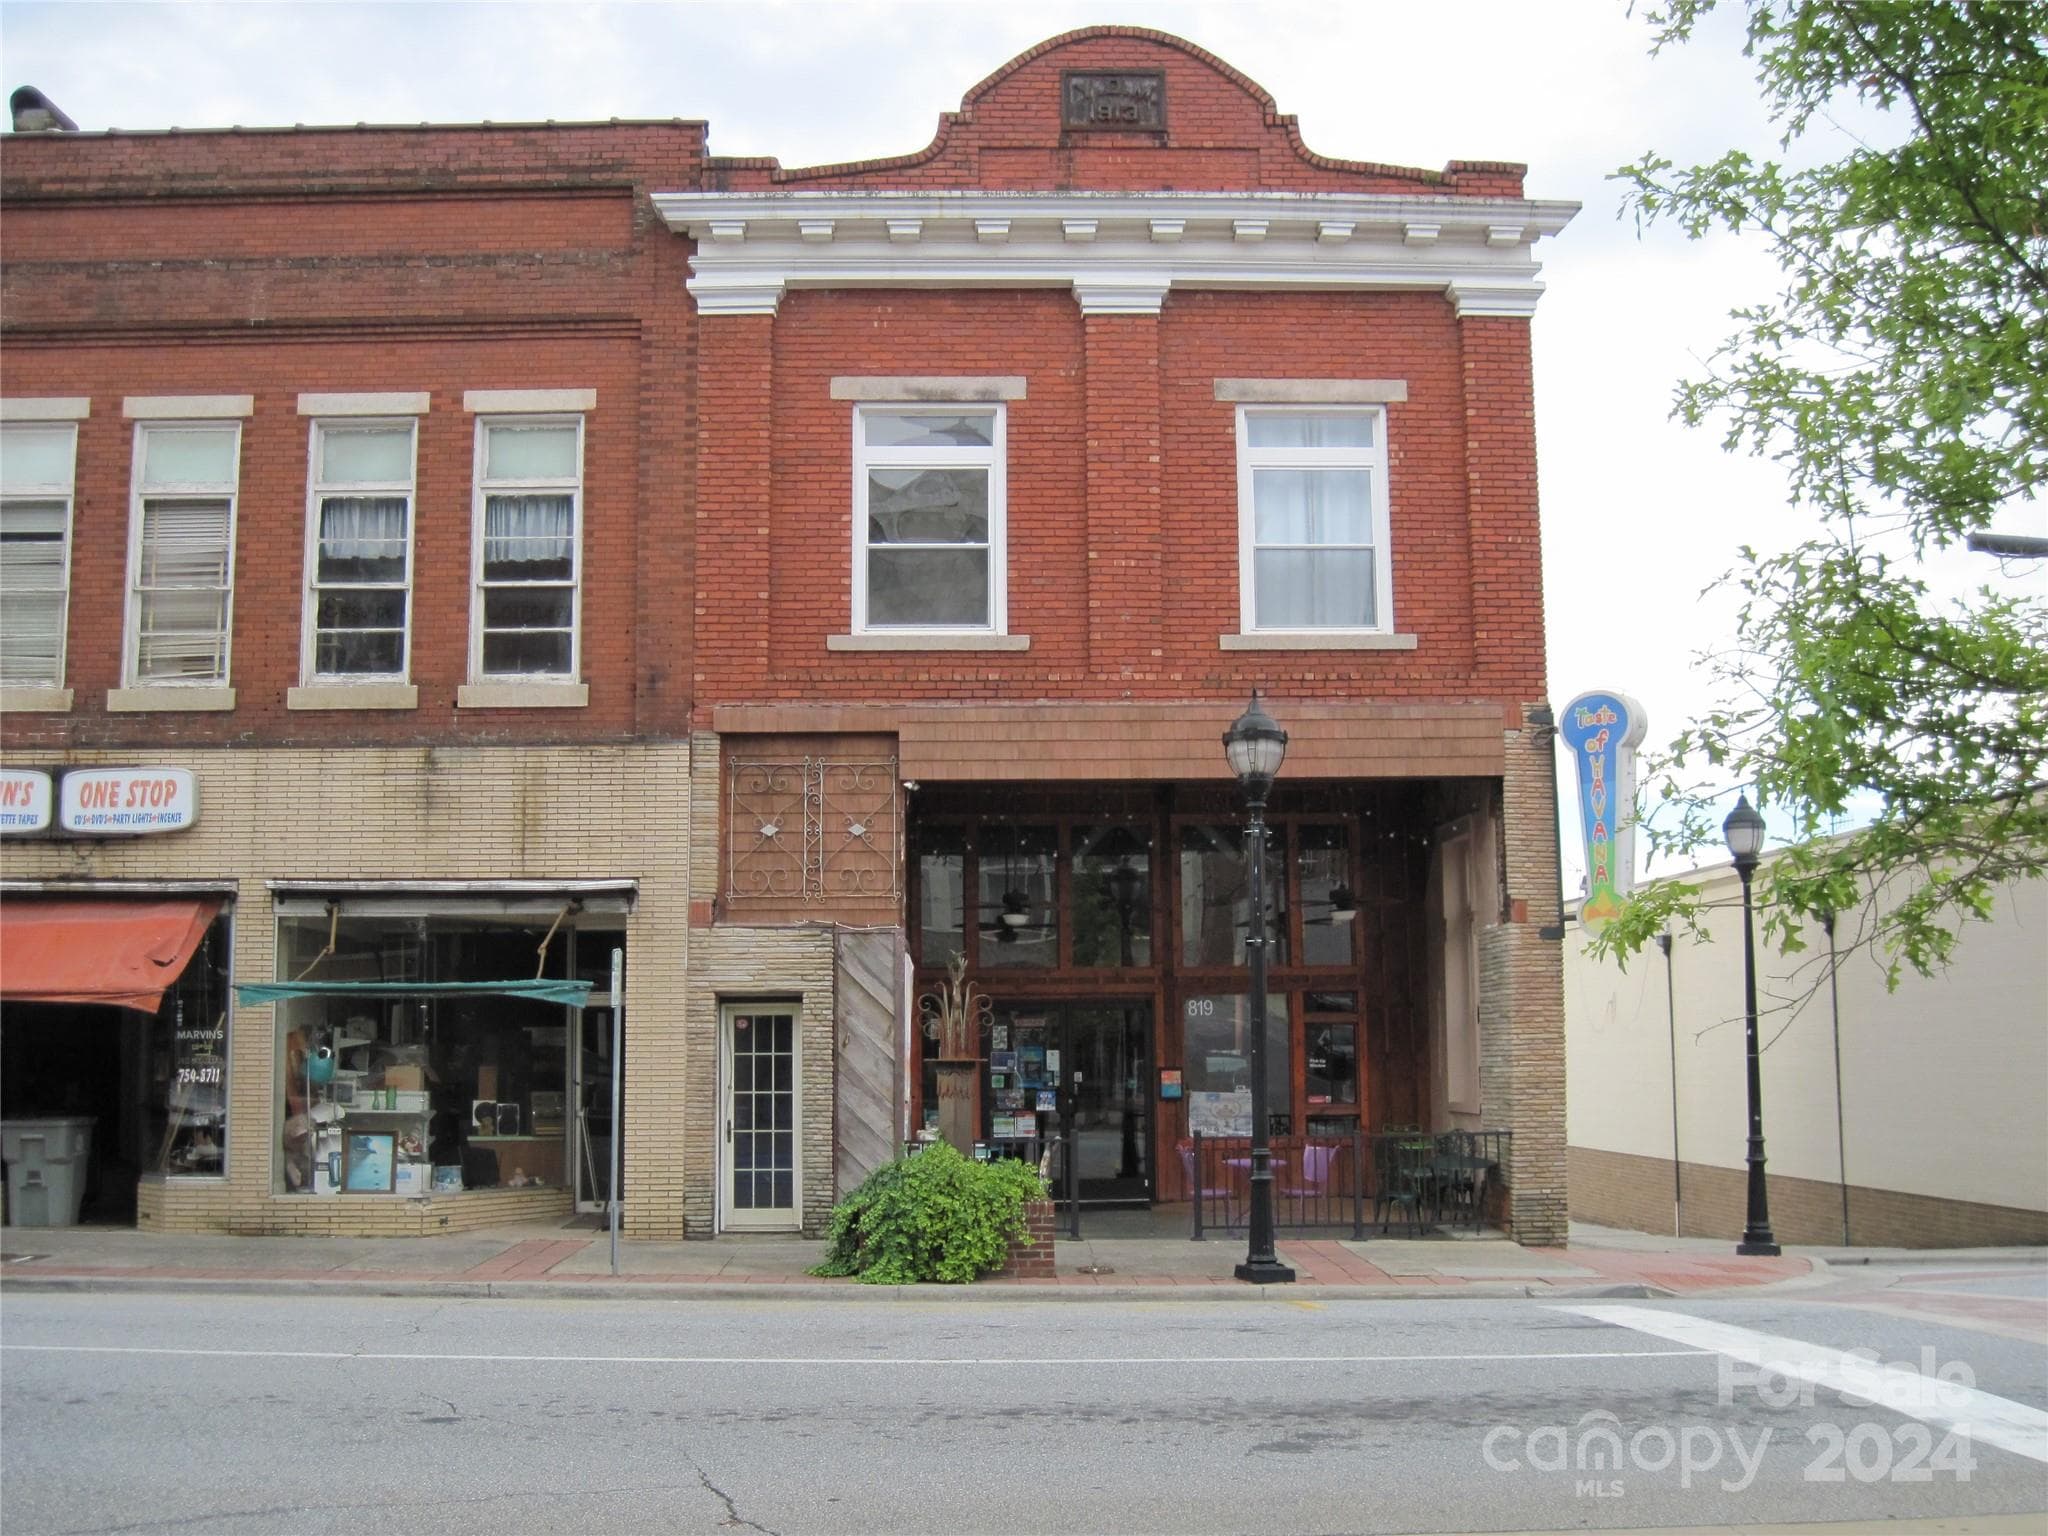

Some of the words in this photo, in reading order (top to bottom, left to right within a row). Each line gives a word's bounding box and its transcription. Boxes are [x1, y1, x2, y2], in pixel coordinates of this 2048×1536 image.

[1575, 704, 1617, 729] Taste
[1585, 729, 1609, 752] of
[80, 779, 121, 809] ONE
[126, 778, 178, 807] STOP
[18, 813, 39, 825] TAPES
[112, 813, 131, 825] PARTY
[132, 812, 153, 824] LIGHTS
[157, 812, 182, 824] INCENSE
[1589, 755, 1609, 884] HAVANA
[1188, 1000, 1213, 1016] 819
